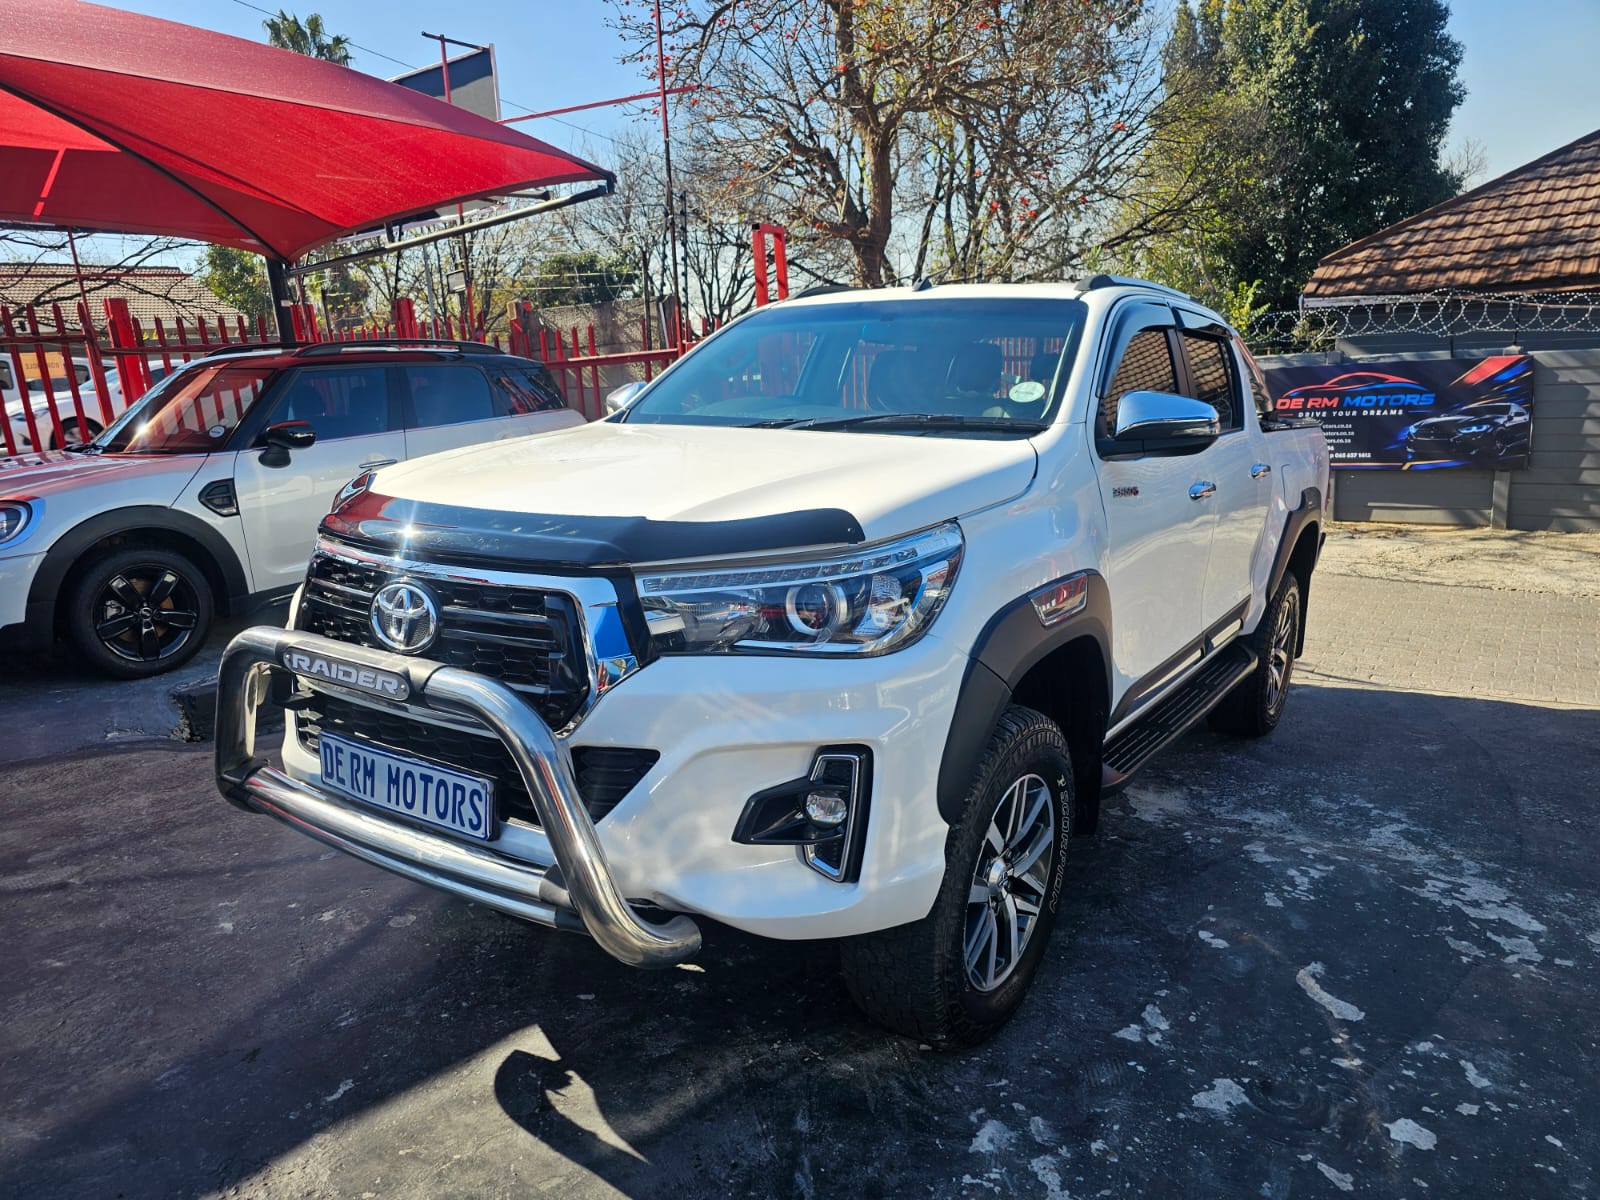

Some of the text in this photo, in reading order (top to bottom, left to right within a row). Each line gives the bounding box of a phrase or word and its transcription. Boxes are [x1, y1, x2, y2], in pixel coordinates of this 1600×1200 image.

[1276, 393, 1435, 410] DE RM MOTORS
[292, 653, 399, 695] RAIDER
[321, 742, 484, 832] DE RM MOTORS
[1049, 790, 1070, 914] SCORPION
